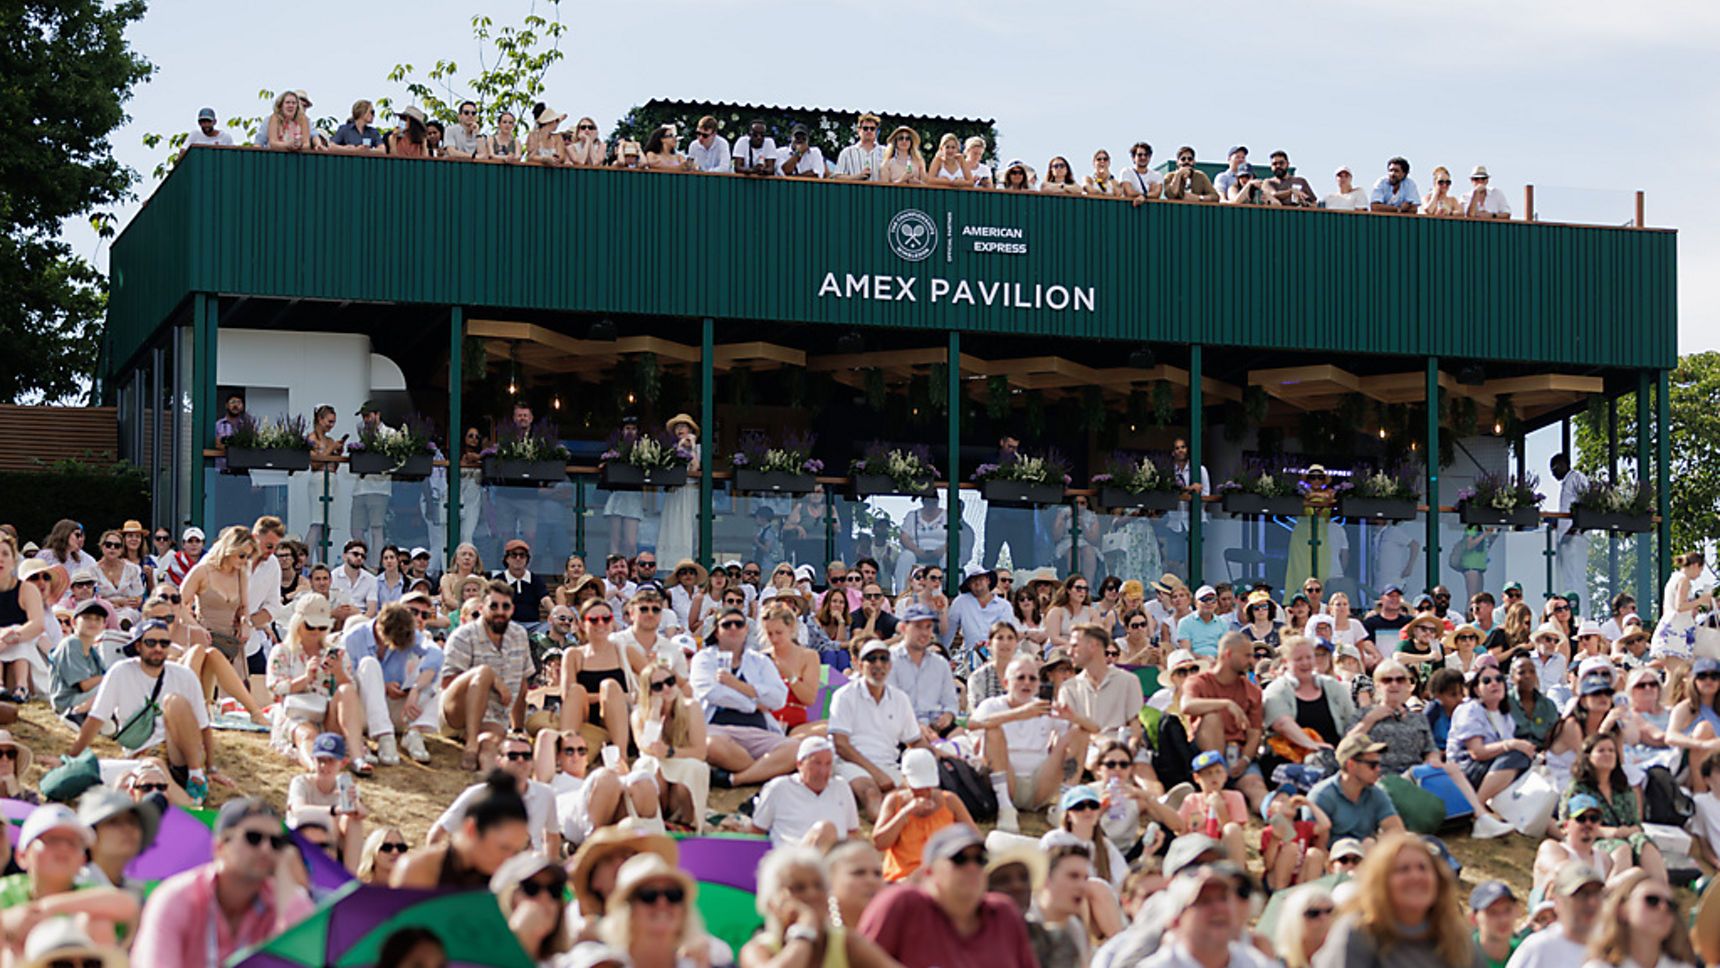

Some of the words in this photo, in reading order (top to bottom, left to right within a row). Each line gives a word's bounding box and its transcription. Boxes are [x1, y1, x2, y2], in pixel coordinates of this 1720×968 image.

[962, 225, 1023, 239] AMERICAN
[973, 241, 1027, 254] EXPRESS
[818, 272, 917, 302] AMEX
[931, 278, 1096, 312] PAVILION
